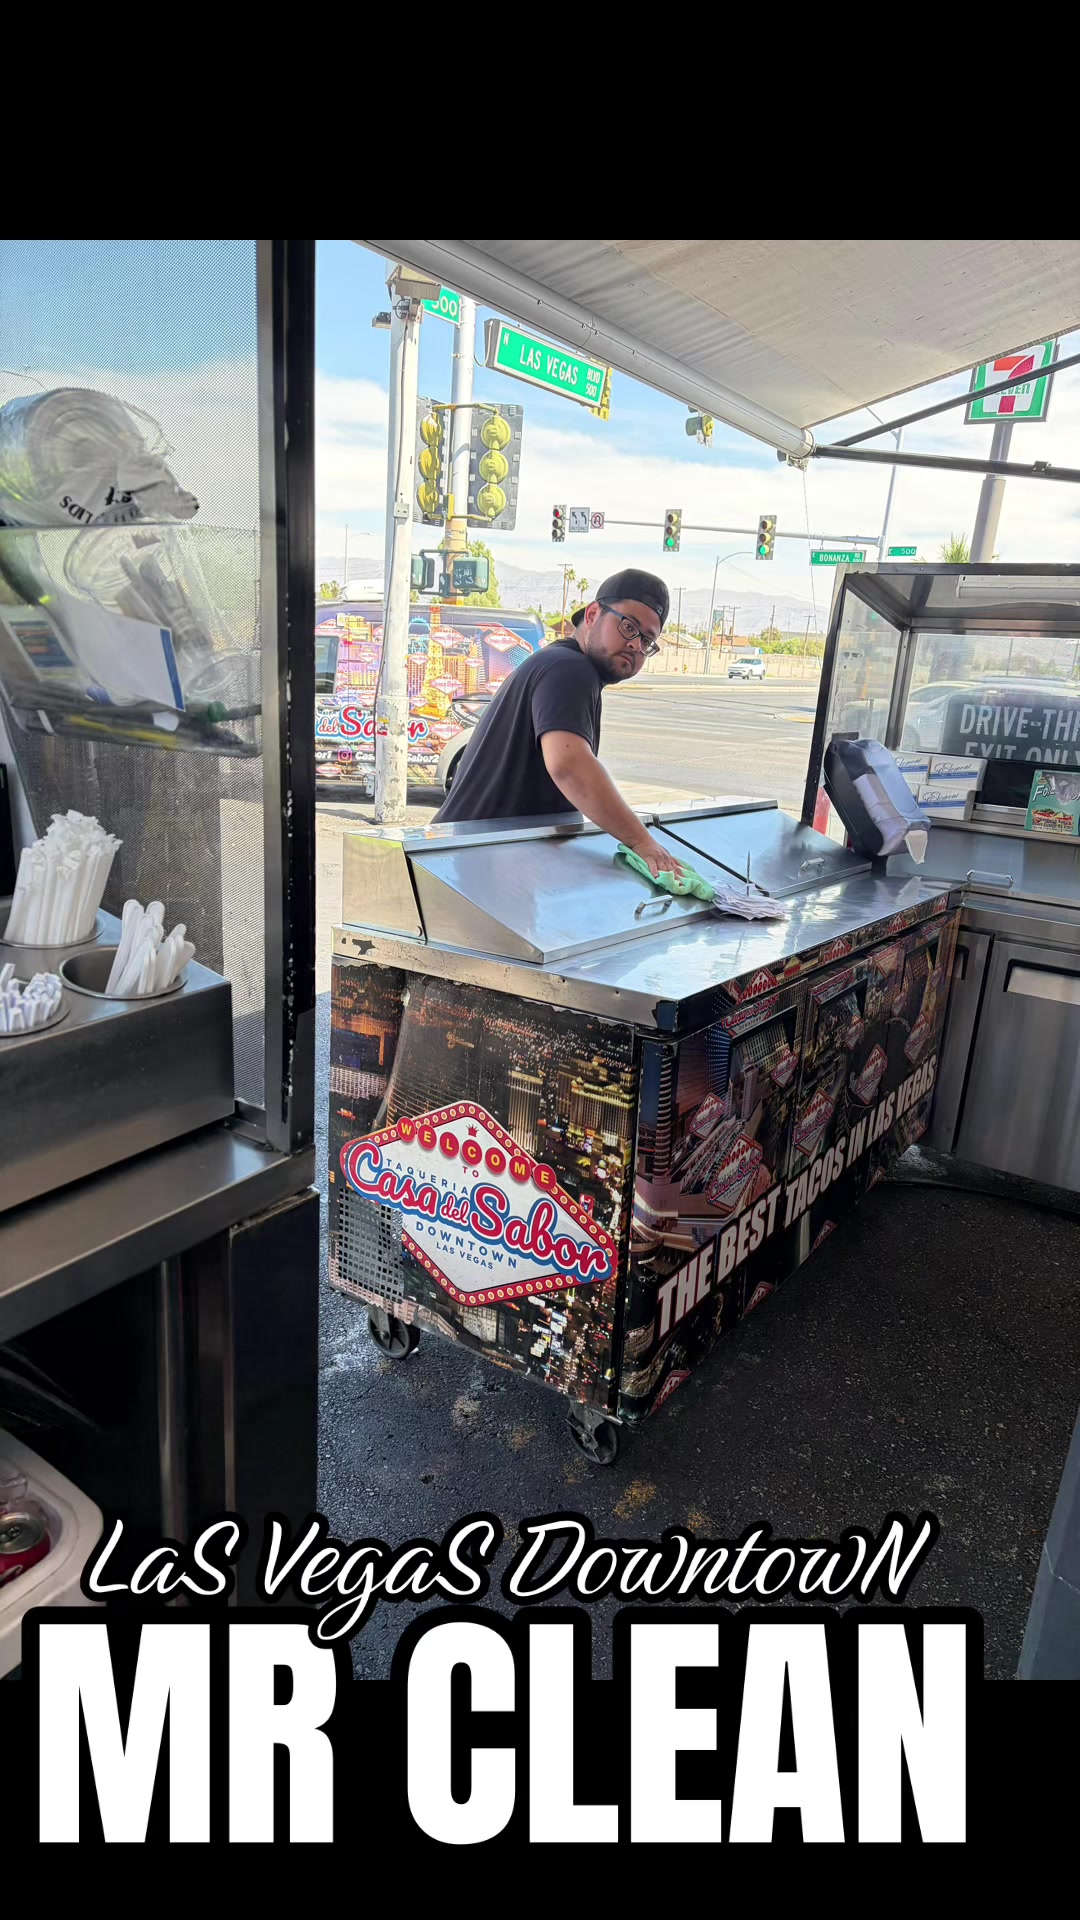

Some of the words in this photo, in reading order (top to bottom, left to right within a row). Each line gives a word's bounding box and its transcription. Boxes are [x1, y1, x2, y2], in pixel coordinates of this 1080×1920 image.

[503, 332, 510, 346] N
[520, 344, 541, 371] LAS
[547, 355, 579, 386] VEGAS
[586, 369, 601, 384] BLVD
[585, 384, 598, 397] 500
[59, 496, 93, 524] LIDS
[820, 554, 850, 562] BONANZA
[319, 719, 337, 732] del
[934, 762, 972, 774] Element
[922, 791, 959, 802] Element
[400, 1121, 550, 1184] WELCOME
[386, 1158, 469, 1195] TAQUERIA
[462, 1165, 479, 1178] TO
[349, 1142, 438, 1214] Casa
[440, 1196, 468, 1226] del
[471, 1186, 607, 1274] Sabor
[658, 1243, 715, 1338] THE
[718, 1186, 781, 1284] BEST
[785, 1143, 845, 1228] TACOS
[847, 1120, 865, 1167] IN
[866, 1091, 895, 1147] LAS
[896, 1056, 937, 1118] VEGAS
[416, 1221, 517, 1268] DOWNTOWN
[436, 1242, 455, 1255] LAS
[459, 1249, 493, 1270] VEGAS
